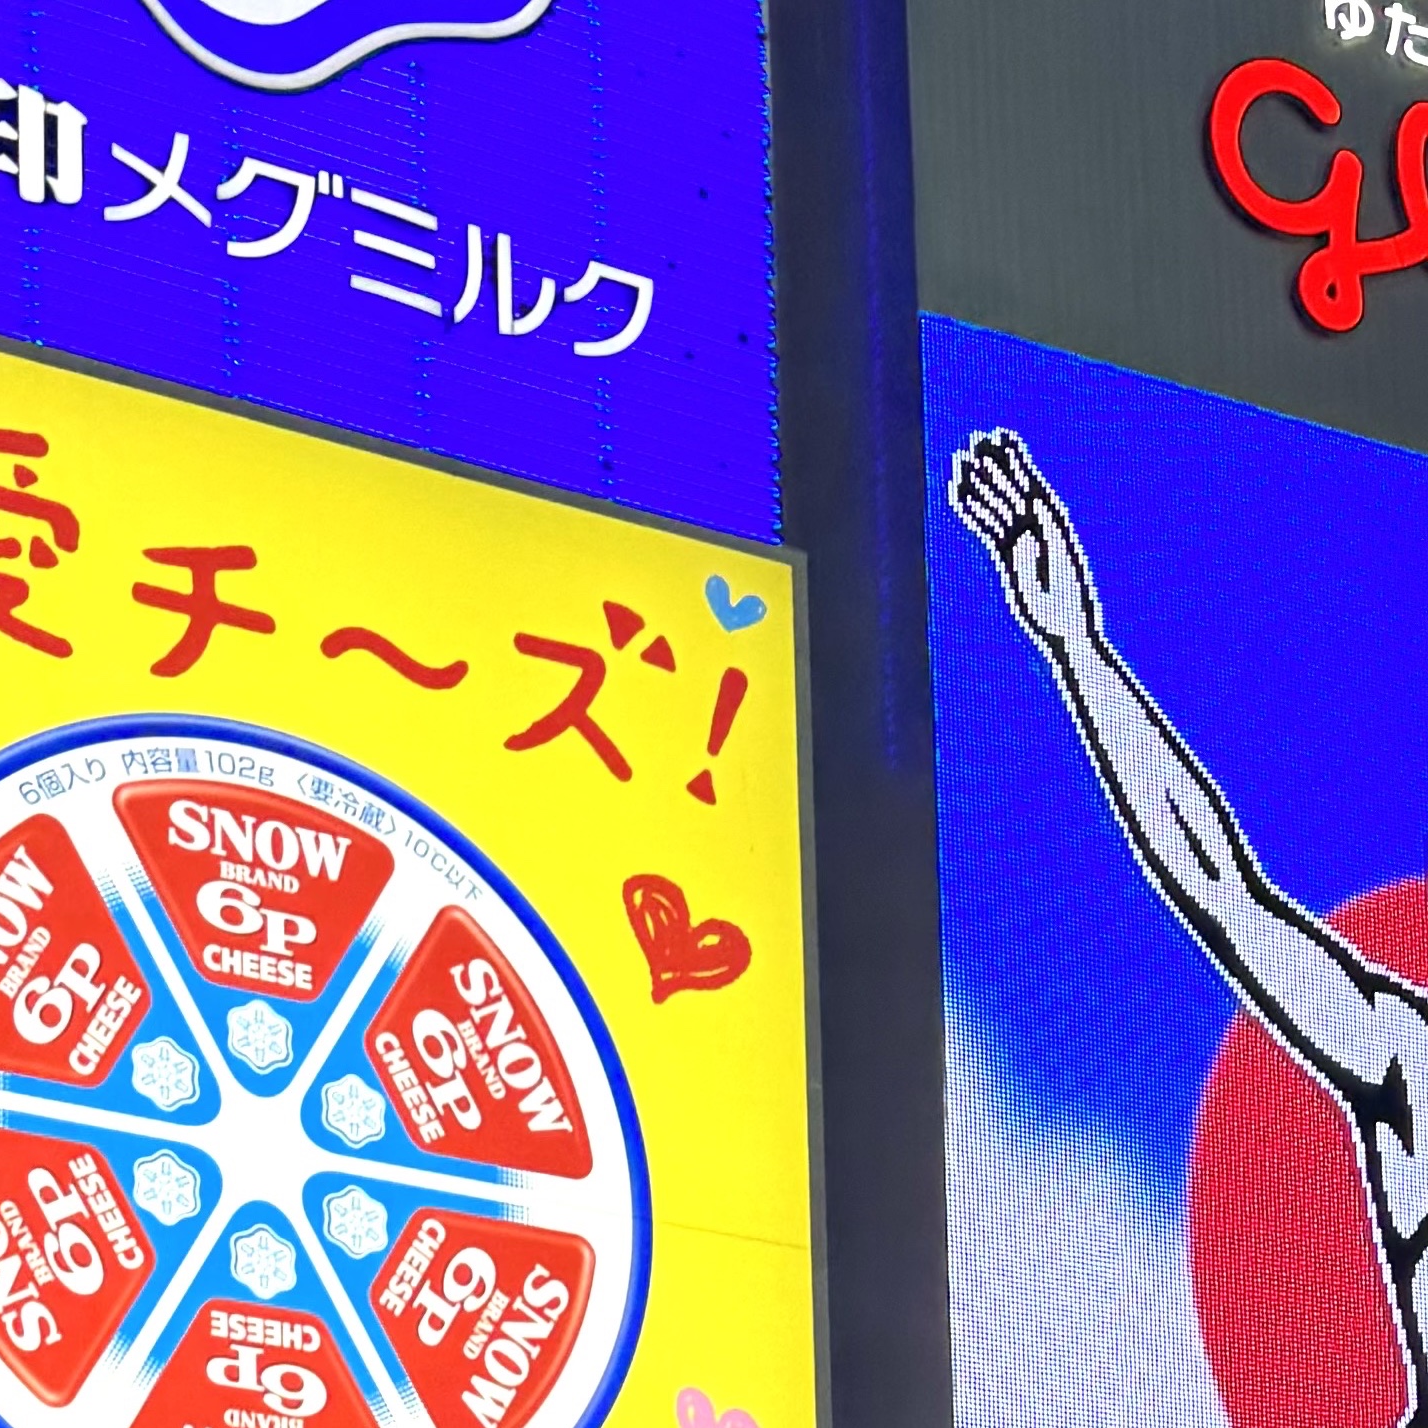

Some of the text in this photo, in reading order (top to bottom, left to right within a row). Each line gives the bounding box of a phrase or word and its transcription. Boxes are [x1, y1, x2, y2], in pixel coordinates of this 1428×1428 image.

[18, 756, 108, 806] 6個入り
[120, 746, 278, 791] 内容量102g
[168, 799, 352, 882] SNOW
[219, 860, 301, 895] BRAND
[203, 944, 314, 991] CHEESE
[68, 974, 143, 1078] CHEESE
[453, 957, 575, 1142] SNOW
[456, 1017, 508, 1100] BRAND
[372, 1029, 446, 1145] CHEESE
[0, 1199, 53, 1286] BRAND
[66, 1153, 146, 1272] CHEESE
[380, 1217, 447, 1318] CHEESE
[209, 1309, 322, 1353] CHEESE
[461, 1292, 509, 1362] BRAND
